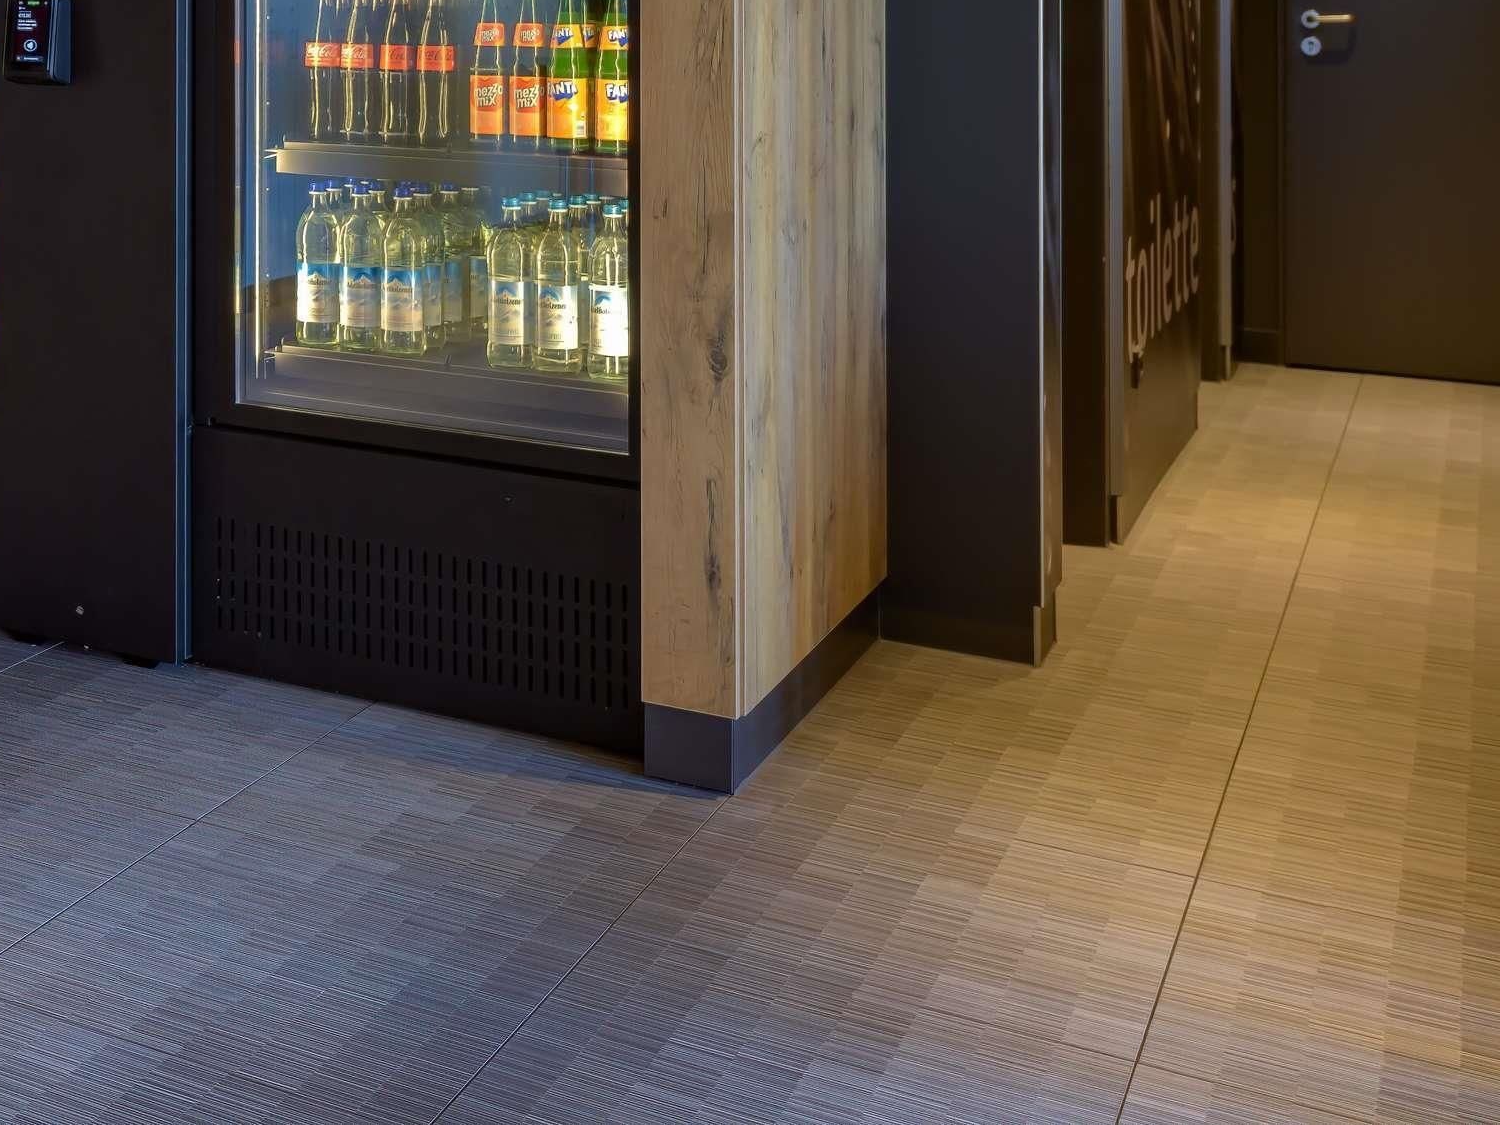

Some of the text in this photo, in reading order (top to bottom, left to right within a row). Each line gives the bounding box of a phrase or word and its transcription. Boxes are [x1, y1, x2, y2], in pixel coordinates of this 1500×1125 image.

[474, 83, 503, 97] mezzo
[606, 82, 628, 98] FAN
[477, 94, 496, 107] mix
[517, 96, 537, 108] mix
[1125, 192, 1199, 364] toilette
